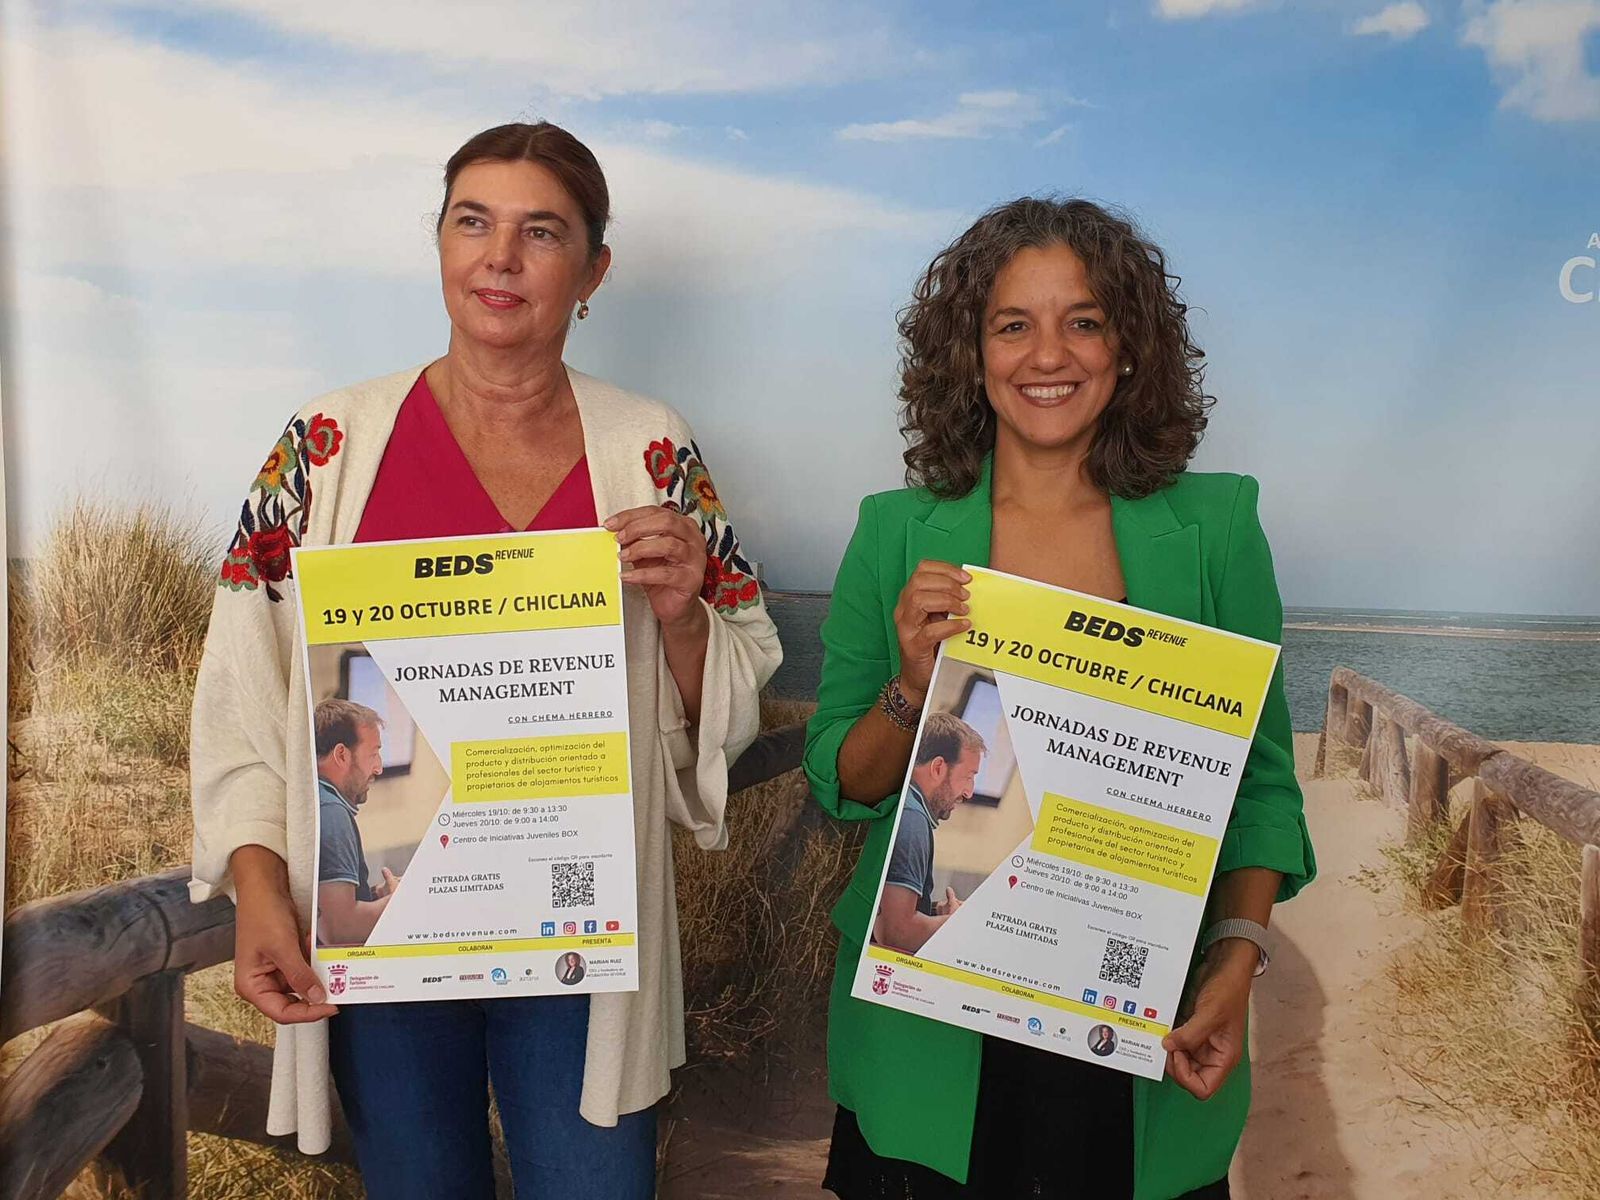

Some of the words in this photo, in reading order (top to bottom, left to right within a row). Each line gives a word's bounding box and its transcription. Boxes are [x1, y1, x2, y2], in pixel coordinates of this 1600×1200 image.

[1559, 255, 1600, 304] C
[414, 553, 493, 578] BEDS
[495, 548, 534, 560] REVENUE
[323, 608, 346, 624] 19
[352, 609, 363, 626] y
[369, 605, 394, 621] 20
[400, 599, 492, 619] OCTUBRE
[498, 598, 507, 615] /
[514, 592, 606, 612] CHICLANA
[1064, 611, 1145, 647] BEDS
[1146, 628, 1188, 647] REVENUE
[395, 662, 493, 682] JORNADAS
[499, 660, 523, 674] DE
[529, 654, 614, 673] REVENUE
[966, 630, 988, 647] 19
[993, 638, 1005, 654] y
[1008, 641, 1033, 659] 20
[1038, 649, 1128, 685] OCTUBRE
[1130, 675, 1144, 689] /
[1148, 678, 1241, 717] CHICLANA
[439, 680, 574, 702] MANAGEMENT
[569, 710, 612, 719] HERRERO
[540, 742, 590, 753] optimización
[593, 740, 605, 748] del
[1011, 705, 1108, 742] JORNADAS
[1112, 732, 1138, 751] DE
[1142, 741, 1231, 777] REVENUE
[466, 758, 502, 769] producto
[511, 755, 557, 765] distribución
[559, 752, 598, 761] orientado
[466, 768, 520, 781] profesionales
[522, 767, 534, 775] del
[1046, 738, 1183, 787] MANAGEMENT
[466, 781, 515, 792] propietarios
[517, 779, 527, 787] de
[530, 777, 581, 788] alojamientos
[548, 804, 567, 812] 13:30
[1106, 787, 1126, 799] CON
[1130, 794, 1162, 808] CHEMA
[1167, 804, 1211, 821] HERRERO
[1050, 826, 1103, 845] profesionales
[1105, 840, 1118, 849] del
[1119, 845, 1144, 856] sector
[1052, 816, 1089, 829] producto
[1097, 826, 1142, 844] distribución
[1145, 841, 1183, 856] orientado
[1128, 825, 1179, 843] optimización
[1181, 838, 1195, 848] del
[1047, 836, 1094, 854] propietarios
[1096, 848, 1107, 857] de
[1109, 853, 1159, 872] alojamientos
[428, 886, 457, 894] PLAZAS
[460, 883, 504, 892] LIMITADAS
[432, 875, 469, 883] ENTRADA
[471, 873, 500, 881] GRATIS
[1023, 866, 1048, 878] Jueves
[1084, 882, 1100, 892] 9:00
[1108, 889, 1127, 900] 14:00
[1026, 857, 1059, 871] Miércoles
[1095, 876, 1111, 886] 9:30
[1119, 883, 1139, 894] 13:30
[1020, 881, 1044, 893] Centro
[1056, 891, 1089, 906] Iniciativas
[1091, 901, 1123, 915] Juveniles
[1125, 910, 1142, 920] BOX
[407, 929, 517, 939] www.bedsrevenue.com
[985, 920, 1014, 934] PLAZAS
[1015, 928, 1058, 946] LIMITADAS
[991, 912, 1026, 927] ENTRADA
[1028, 922, 1057, 935] GRATIS
[896, 957, 923, 968] ORGANIZA
[956, 959, 1060, 991] www.bedsrevenue.com
[1001, 985, 1034, 999] COLABORAN
[1118, 1017, 1146, 1028] PRESENTA
